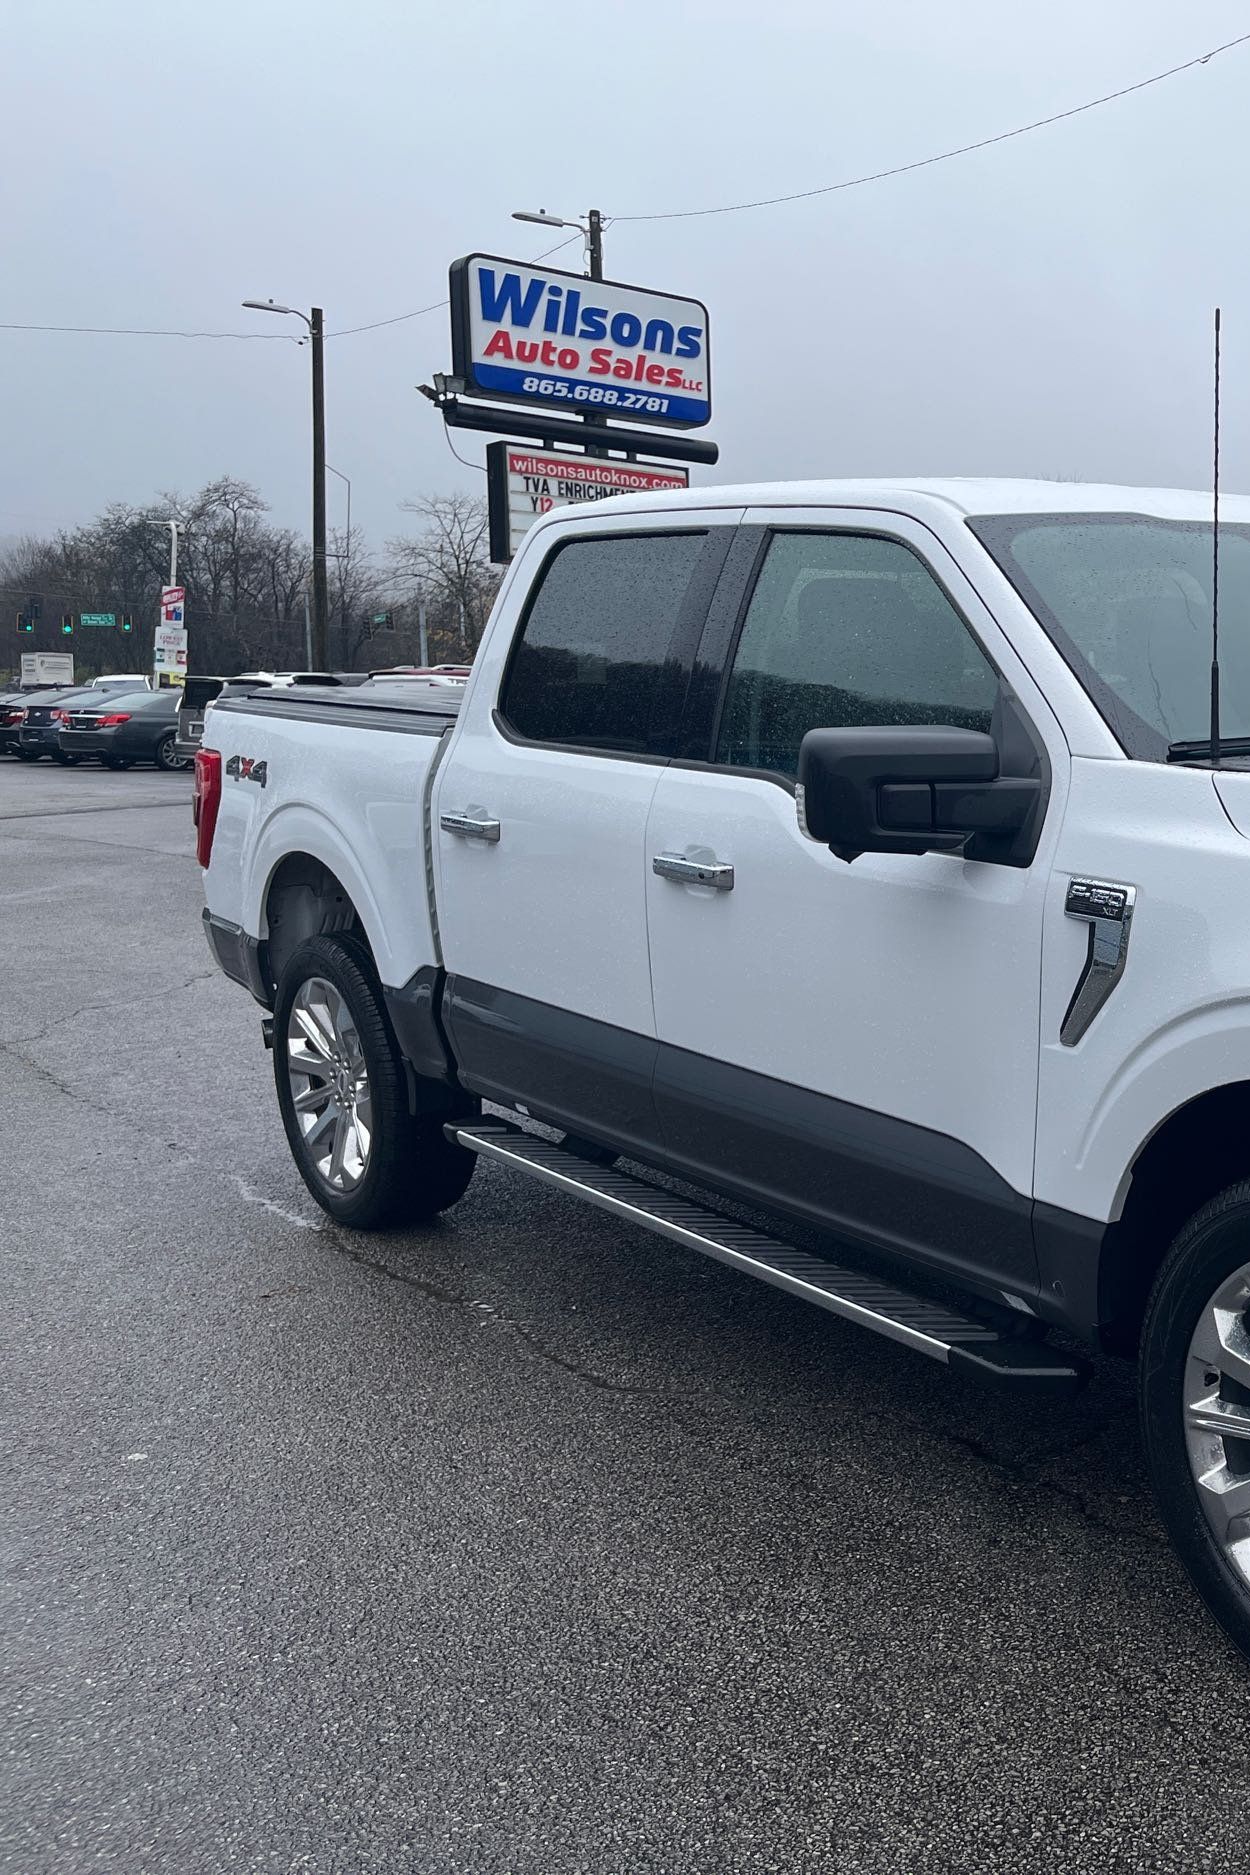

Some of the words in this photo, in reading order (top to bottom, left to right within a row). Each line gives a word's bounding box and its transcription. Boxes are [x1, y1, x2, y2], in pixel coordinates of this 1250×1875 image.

[478, 267, 703, 359] Wilsons
[483, 329, 580, 370] Auto
[588, 347, 684, 388] Sales
[682, 379, 703, 392] LLC
[522, 376, 670, 414] 865.688.2781
[513, 458, 683, 489] wilsonsautoknox.com
[523, 476, 550, 494] TVA
[530, 495, 553, 512] Y12
[1069, 885, 1124, 907] F-150
[1103, 906, 1119, 917] XLT
